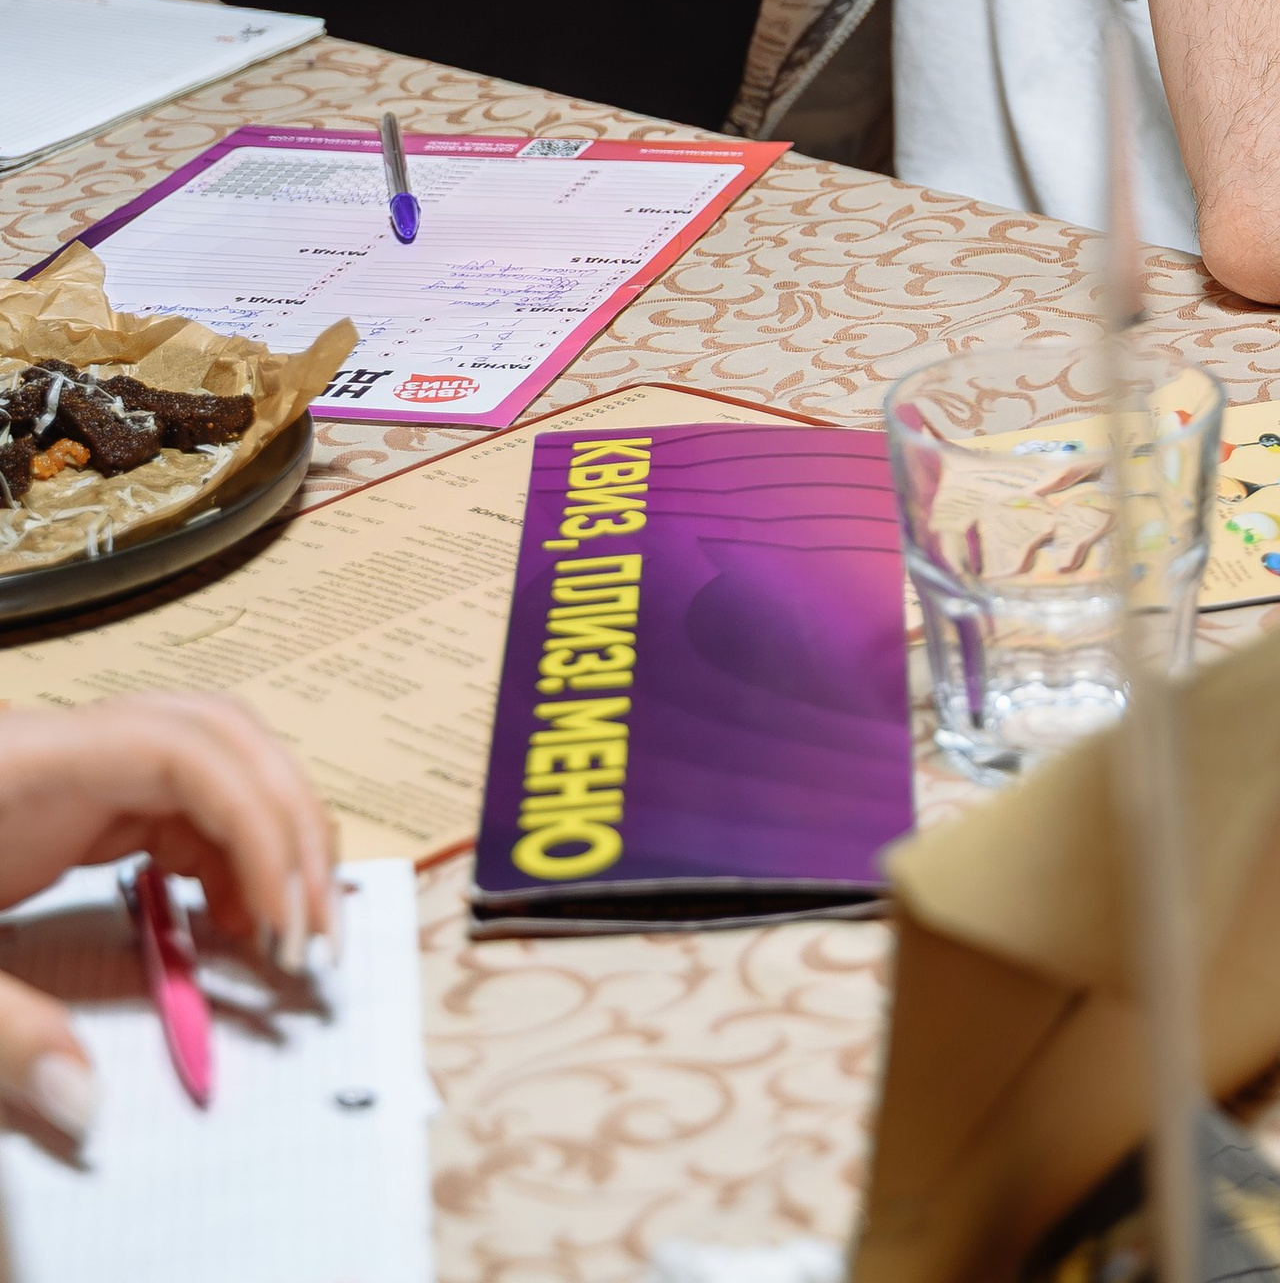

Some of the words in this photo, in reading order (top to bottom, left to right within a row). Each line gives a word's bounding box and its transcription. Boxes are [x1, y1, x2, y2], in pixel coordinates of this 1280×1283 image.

[584, 256, 642, 265] РАУНД
[249, 297, 306, 306] РАУНД
[525, 306, 589, 314] РАУНД
[469, 362, 532, 371] РАУНД
[540, 436, 653, 552] КВИЗ,
[532, 553, 645, 696] ПЛИЗ!
[509, 696, 631, 882] МЕНЮ
